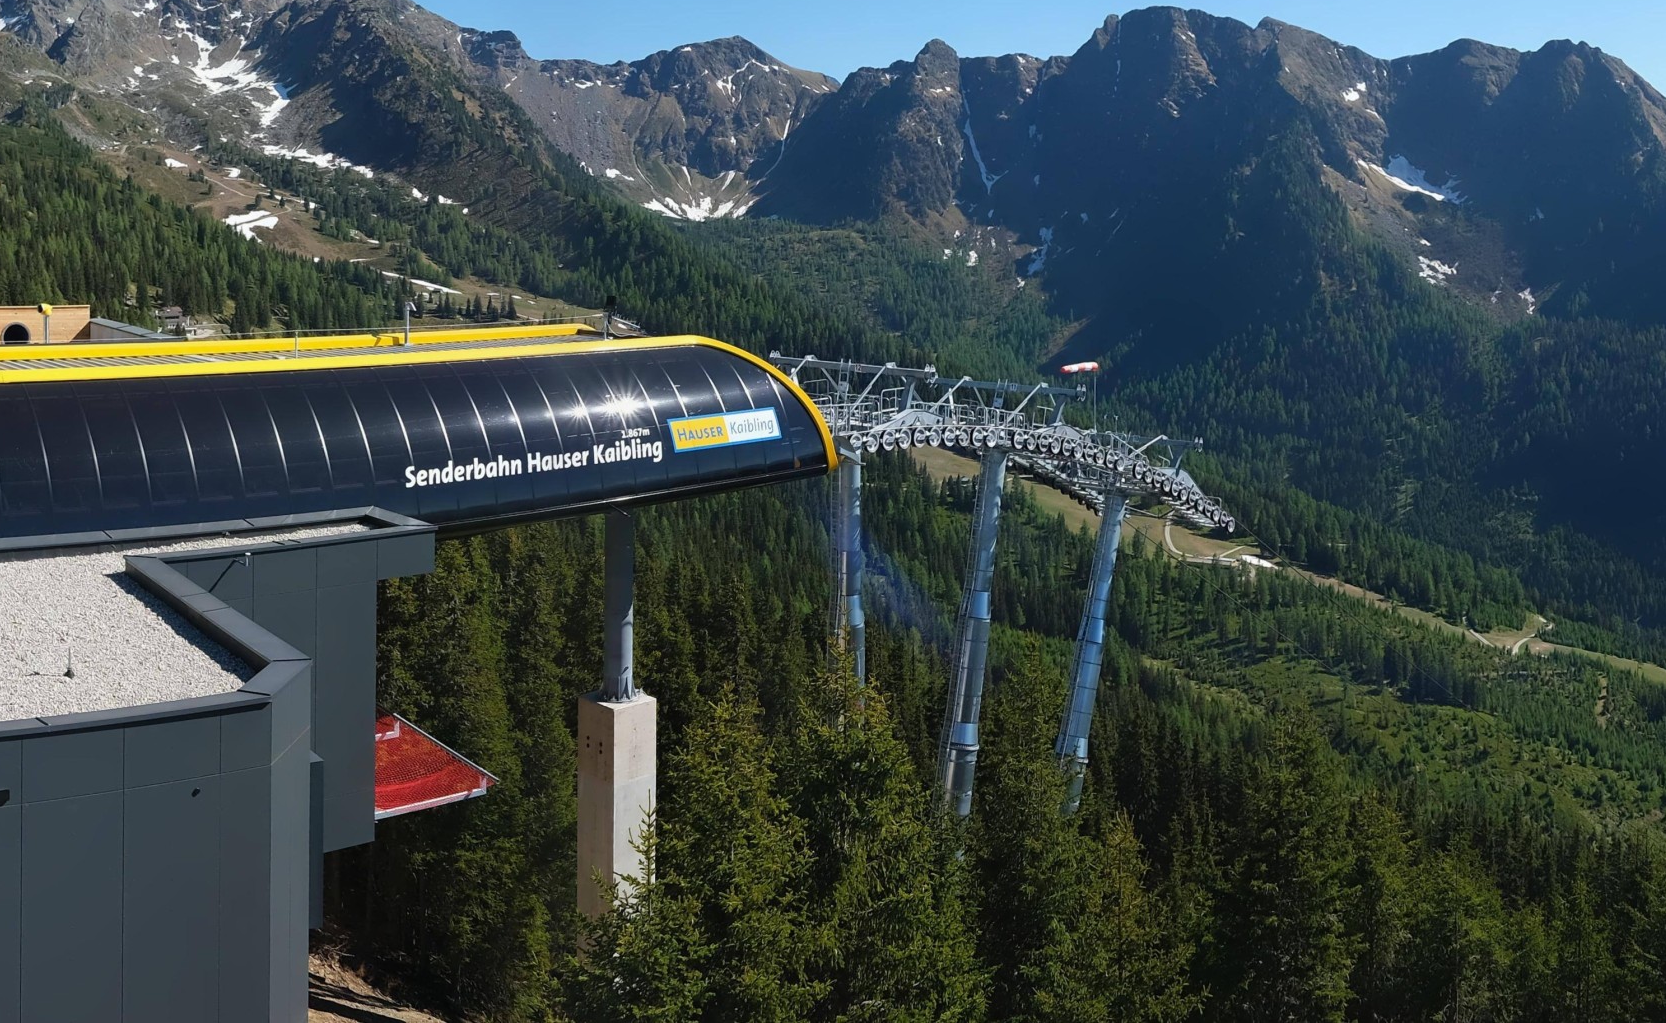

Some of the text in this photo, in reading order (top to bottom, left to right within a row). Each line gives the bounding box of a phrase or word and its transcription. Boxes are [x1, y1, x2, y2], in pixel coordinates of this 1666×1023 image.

[621, 427, 650, 439] 1.867m
[676, 415, 774, 442] HAUSER Kaibling
[405, 438, 663, 488] Senderbahn Hauser Kaibling
